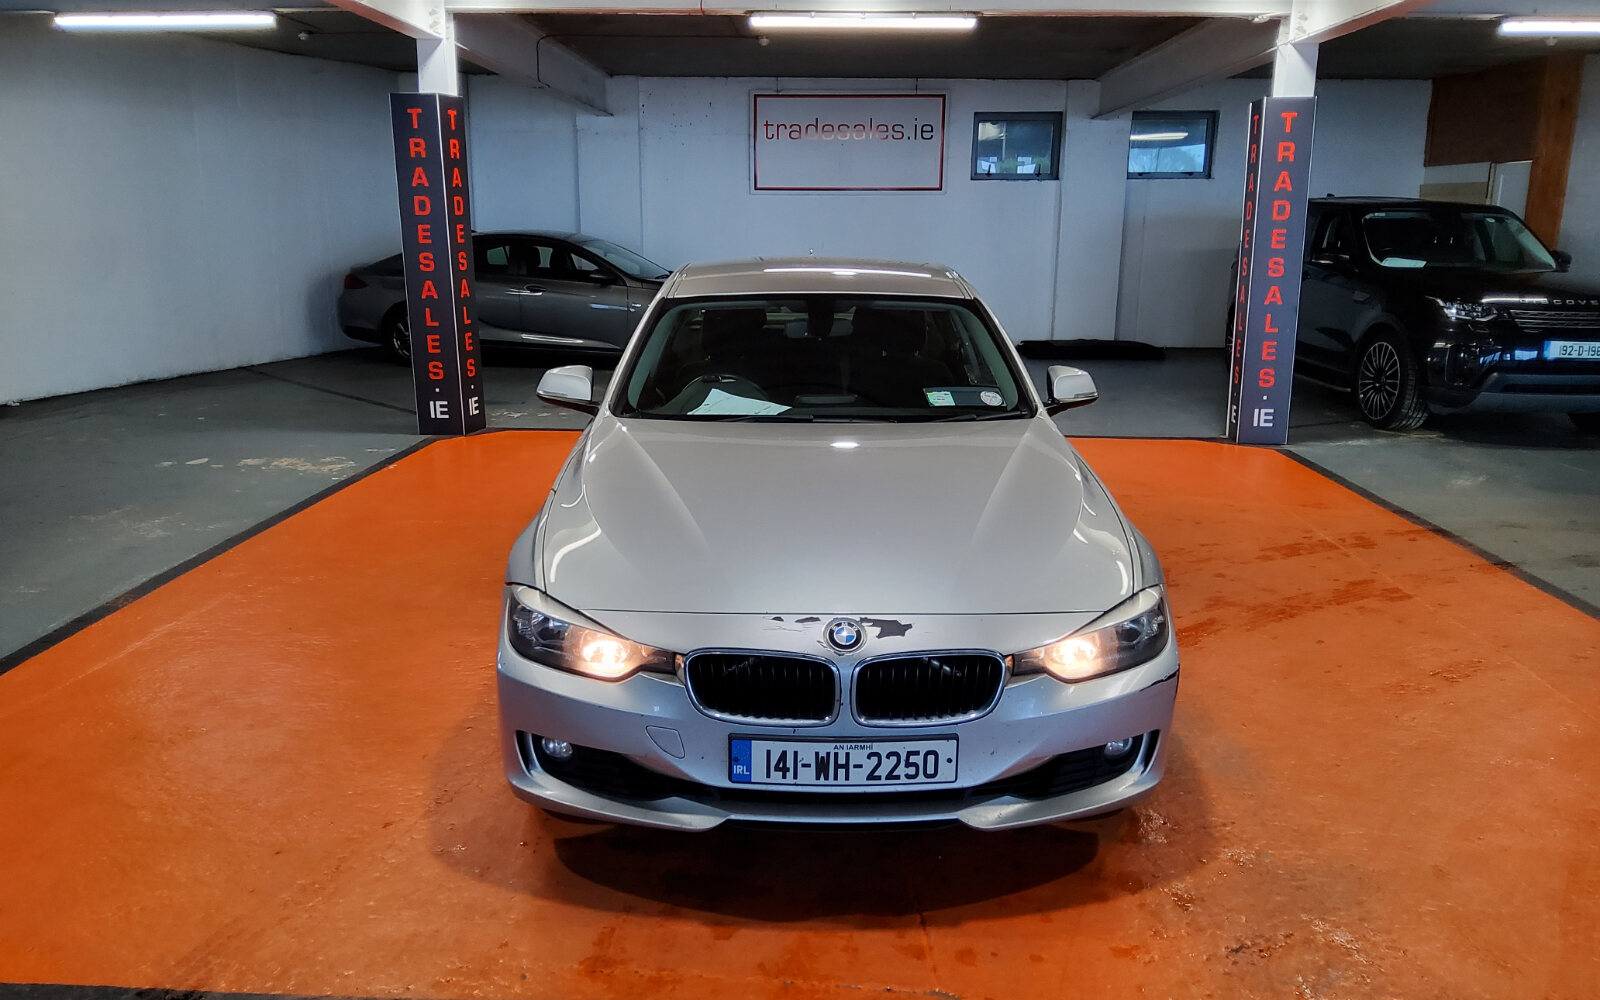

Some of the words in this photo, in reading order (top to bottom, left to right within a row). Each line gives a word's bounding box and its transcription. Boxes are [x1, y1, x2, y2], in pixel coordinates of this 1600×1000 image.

[764, 117, 934, 141] tradesales.ie
[733, 764, 750, 775] IRL
[765, 749, 939, 781] 141-WH-2250
